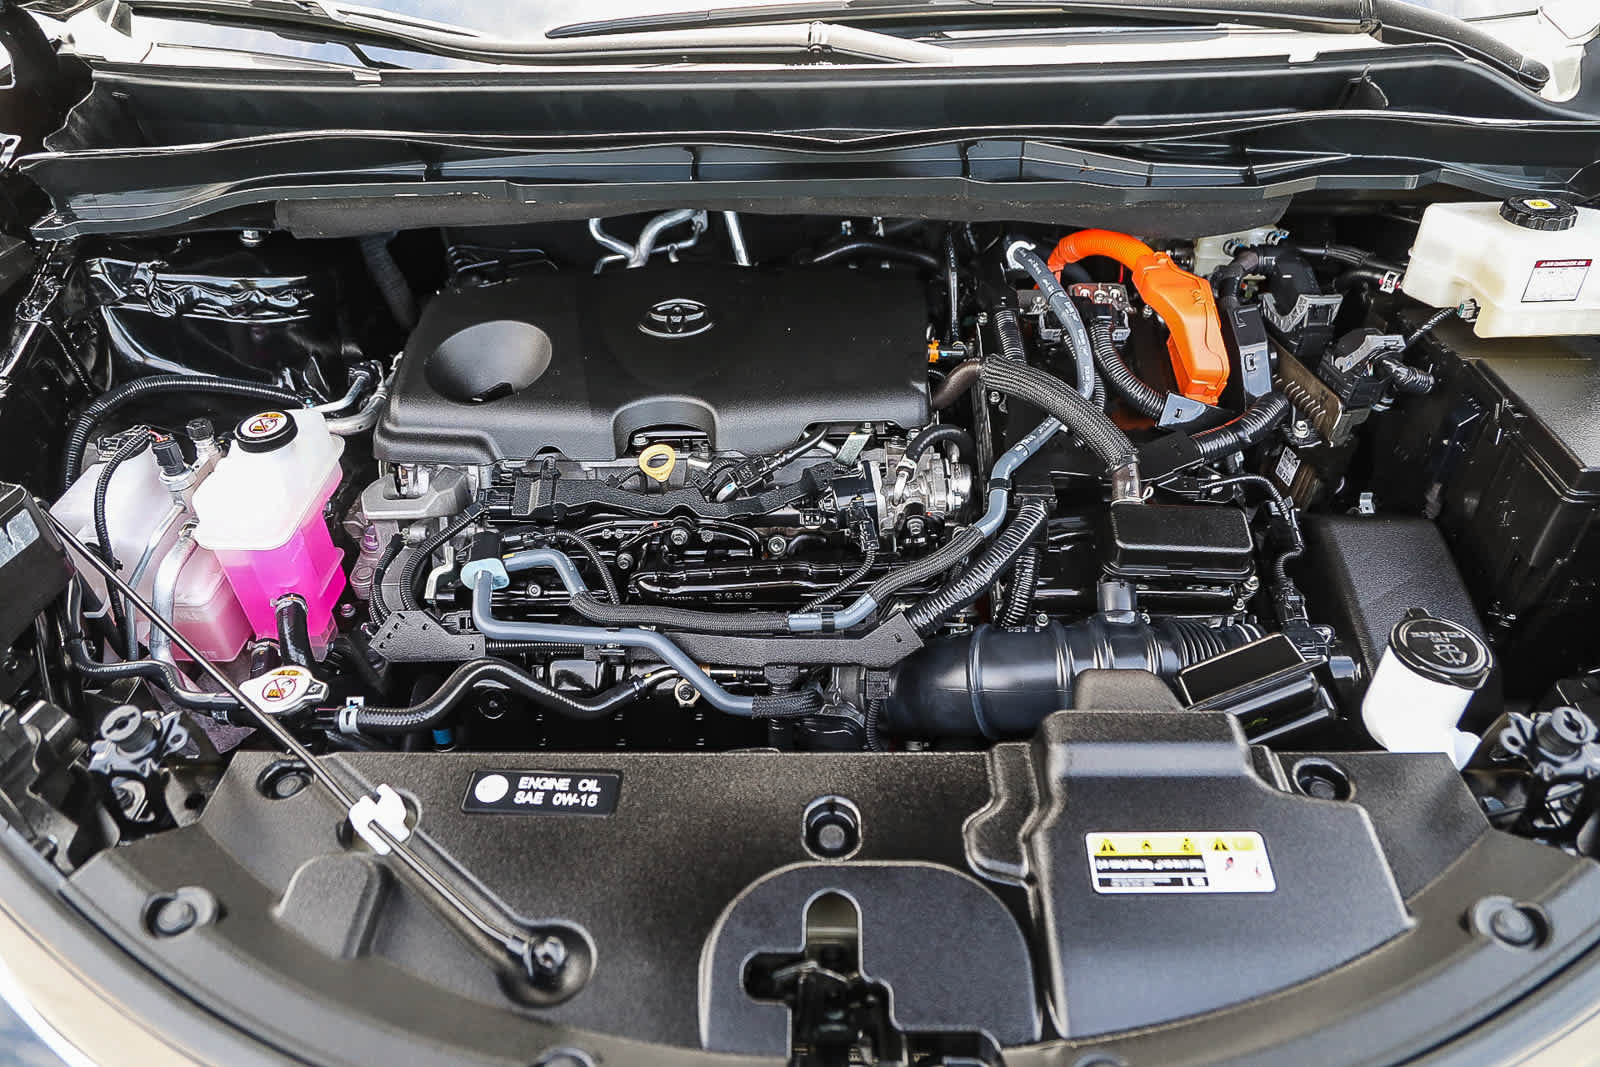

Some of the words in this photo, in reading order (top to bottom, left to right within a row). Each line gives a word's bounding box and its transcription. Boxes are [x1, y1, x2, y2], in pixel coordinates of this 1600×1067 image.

[518, 776, 571, 791] ENGINE
[578, 779, 601, 792] OIL
[513, 790, 545, 805] SAE
[552, 792, 598, 807] 0W-16
